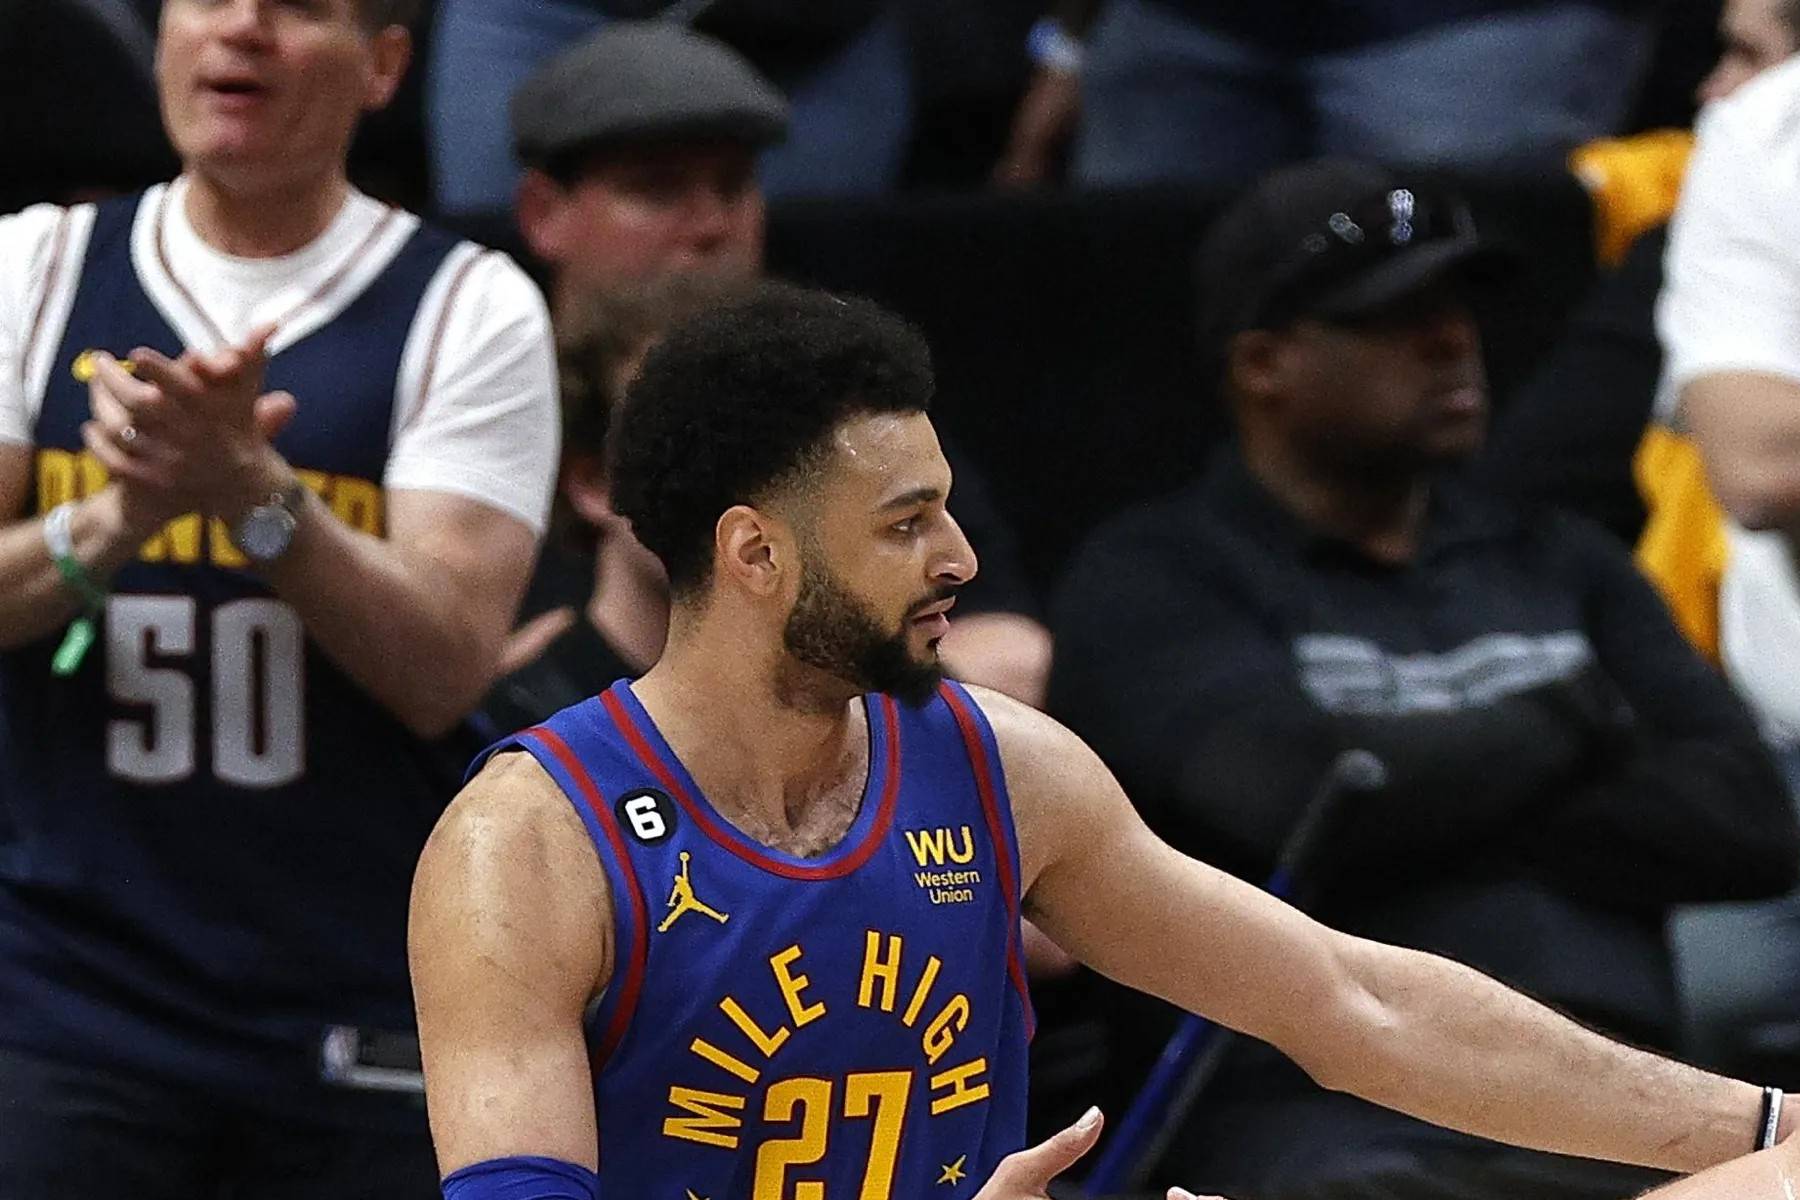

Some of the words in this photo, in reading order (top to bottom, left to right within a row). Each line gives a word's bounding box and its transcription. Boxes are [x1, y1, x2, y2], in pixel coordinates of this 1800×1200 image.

[105, 594, 304, 787] 50
[625, 795, 666, 840] 6
[905, 826, 974, 867] WU
[914, 870, 981, 888] Western
[929, 886, 973, 904] Union
[662, 944, 827, 1150] MILE
[857, 930, 990, 1116] HIGH
